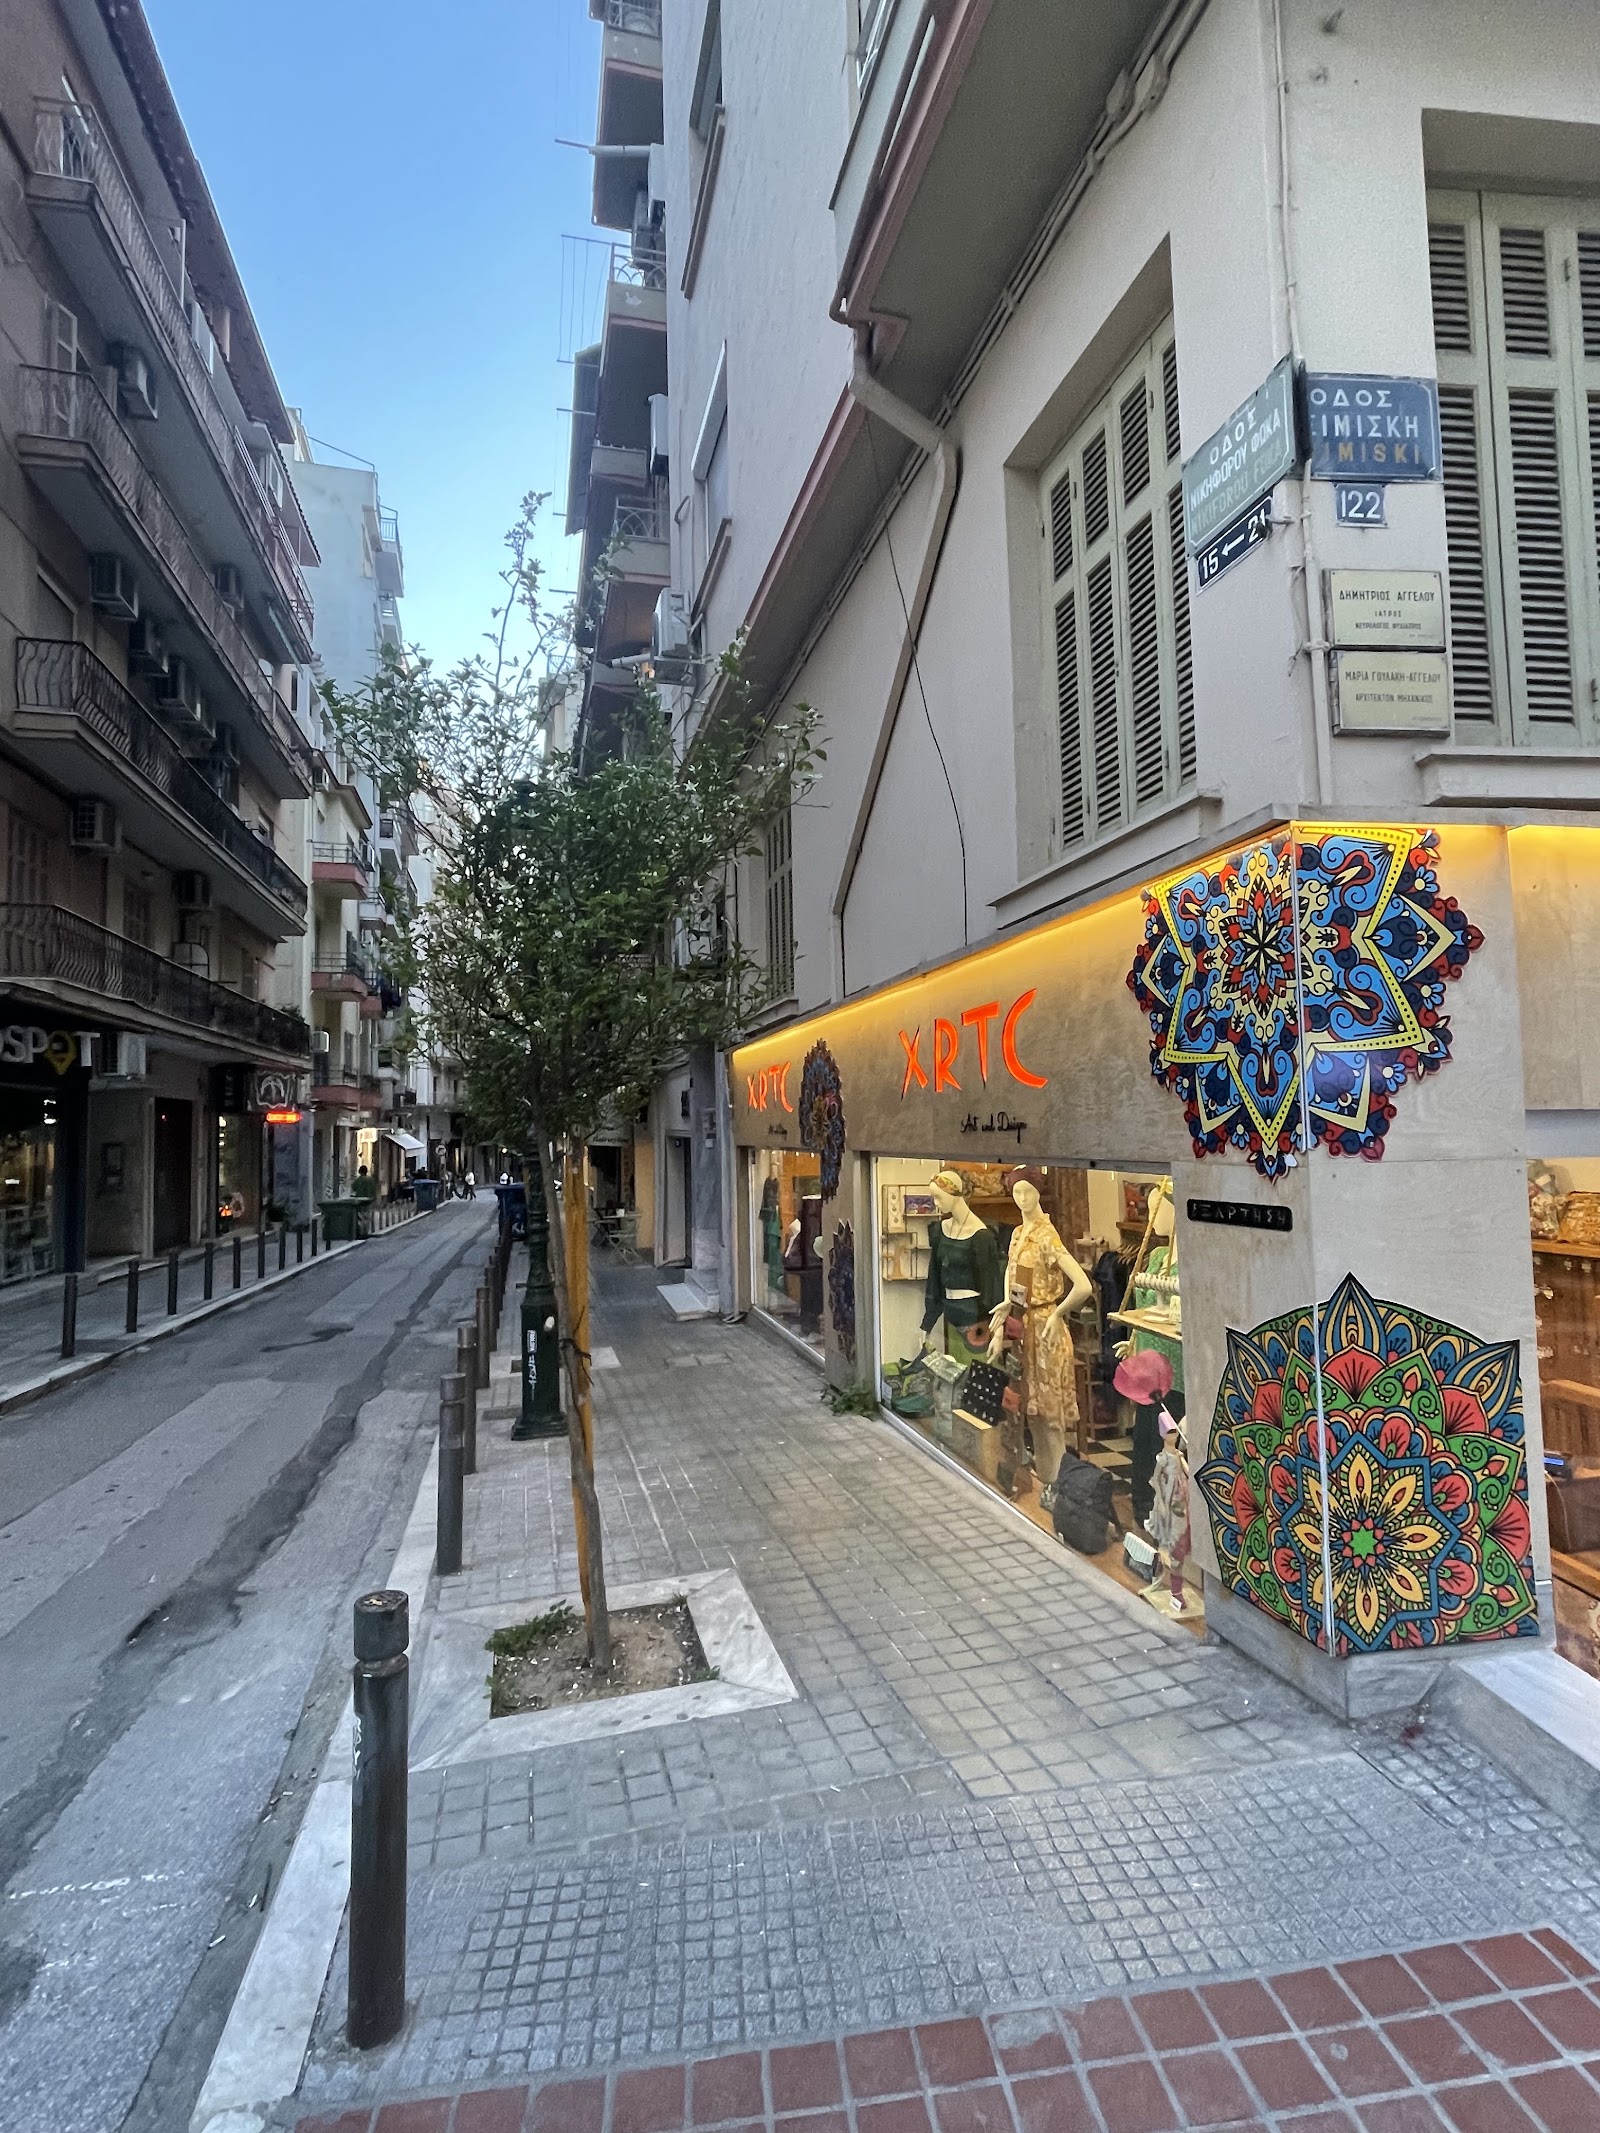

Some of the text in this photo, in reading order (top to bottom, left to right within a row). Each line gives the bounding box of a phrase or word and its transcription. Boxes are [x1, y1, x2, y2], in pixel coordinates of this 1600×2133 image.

[1309, 388, 1393, 408] ΟΔΟΣ
[1209, 407, 1257, 466] ΟΔΟΣ
[1190, 408, 1281, 512] ΝΙΚΗΦΟΡΟΥ ΦΩΚΑ
[1325, 441, 1420, 465] IMISKI
[1341, 489, 1382, 519] 122
[1202, 547, 1219, 580] 15
[1339, 590, 1435, 602] ΔΗΜΗΤΡΙΟΣ ΑΓΓΕΛΟΥ
[1374, 609, 1402, 618] ΙΑΤΡΟΣ
[1345, 670, 1369, 681] ΜΑΡΙΑ
[0, 1025, 100, 1074] SPOT
[898, 987, 1049, 1102] XRTC
[746, 1060, 794, 1116] XRTC
